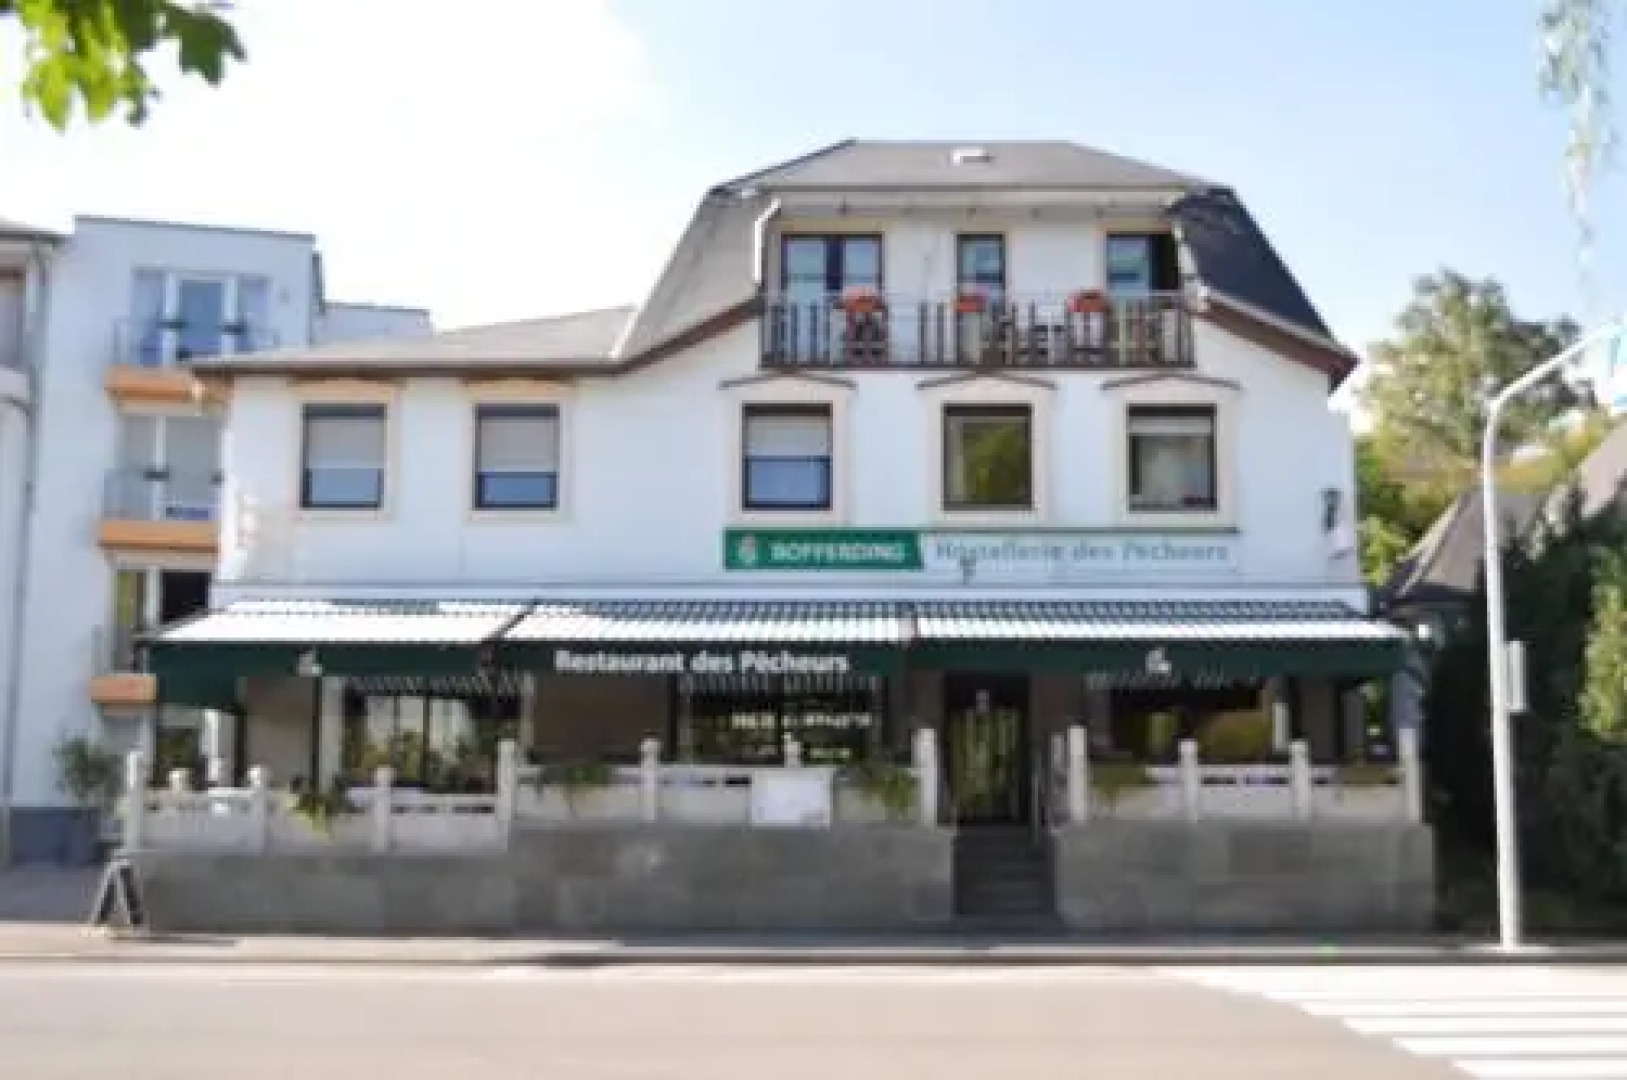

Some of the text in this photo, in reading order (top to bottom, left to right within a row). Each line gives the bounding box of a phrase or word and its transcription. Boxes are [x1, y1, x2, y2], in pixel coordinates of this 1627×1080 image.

[1073, 539, 1114, 561] des
[555, 650, 848, 672] Restaurant des Pêcheurs
